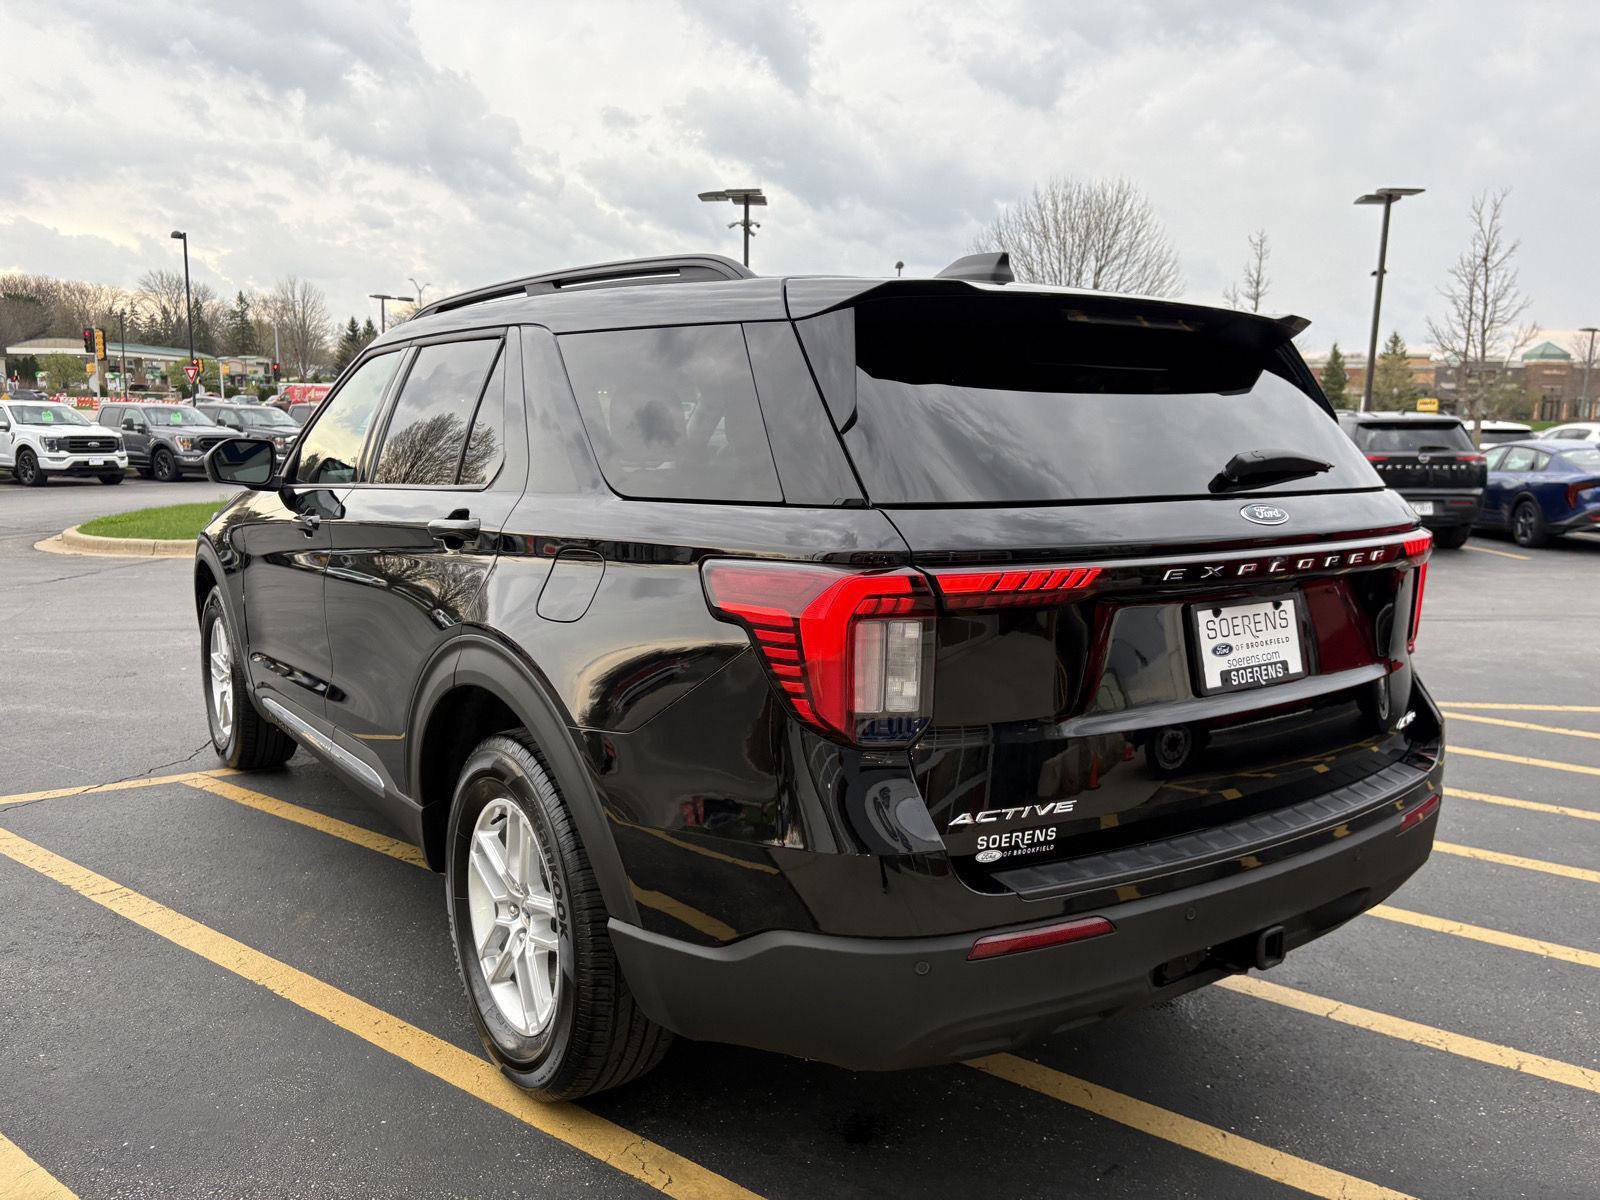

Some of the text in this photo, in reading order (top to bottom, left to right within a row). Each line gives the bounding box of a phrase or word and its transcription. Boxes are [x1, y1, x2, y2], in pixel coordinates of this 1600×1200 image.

[1163, 550, 1385, 581] EXPLORER
[1206, 609, 1290, 640] SOERENS
[1235, 636, 1290, 651] OF BROOKFIELD
[1227, 651, 1280, 668] soerens.com
[1231, 664, 1284, 685] SOERENS
[948, 800, 1077, 826] ACTIVE
[977, 827, 1057, 849] SOERENS
[1013, 844, 1055, 857] BROOKFIELD
